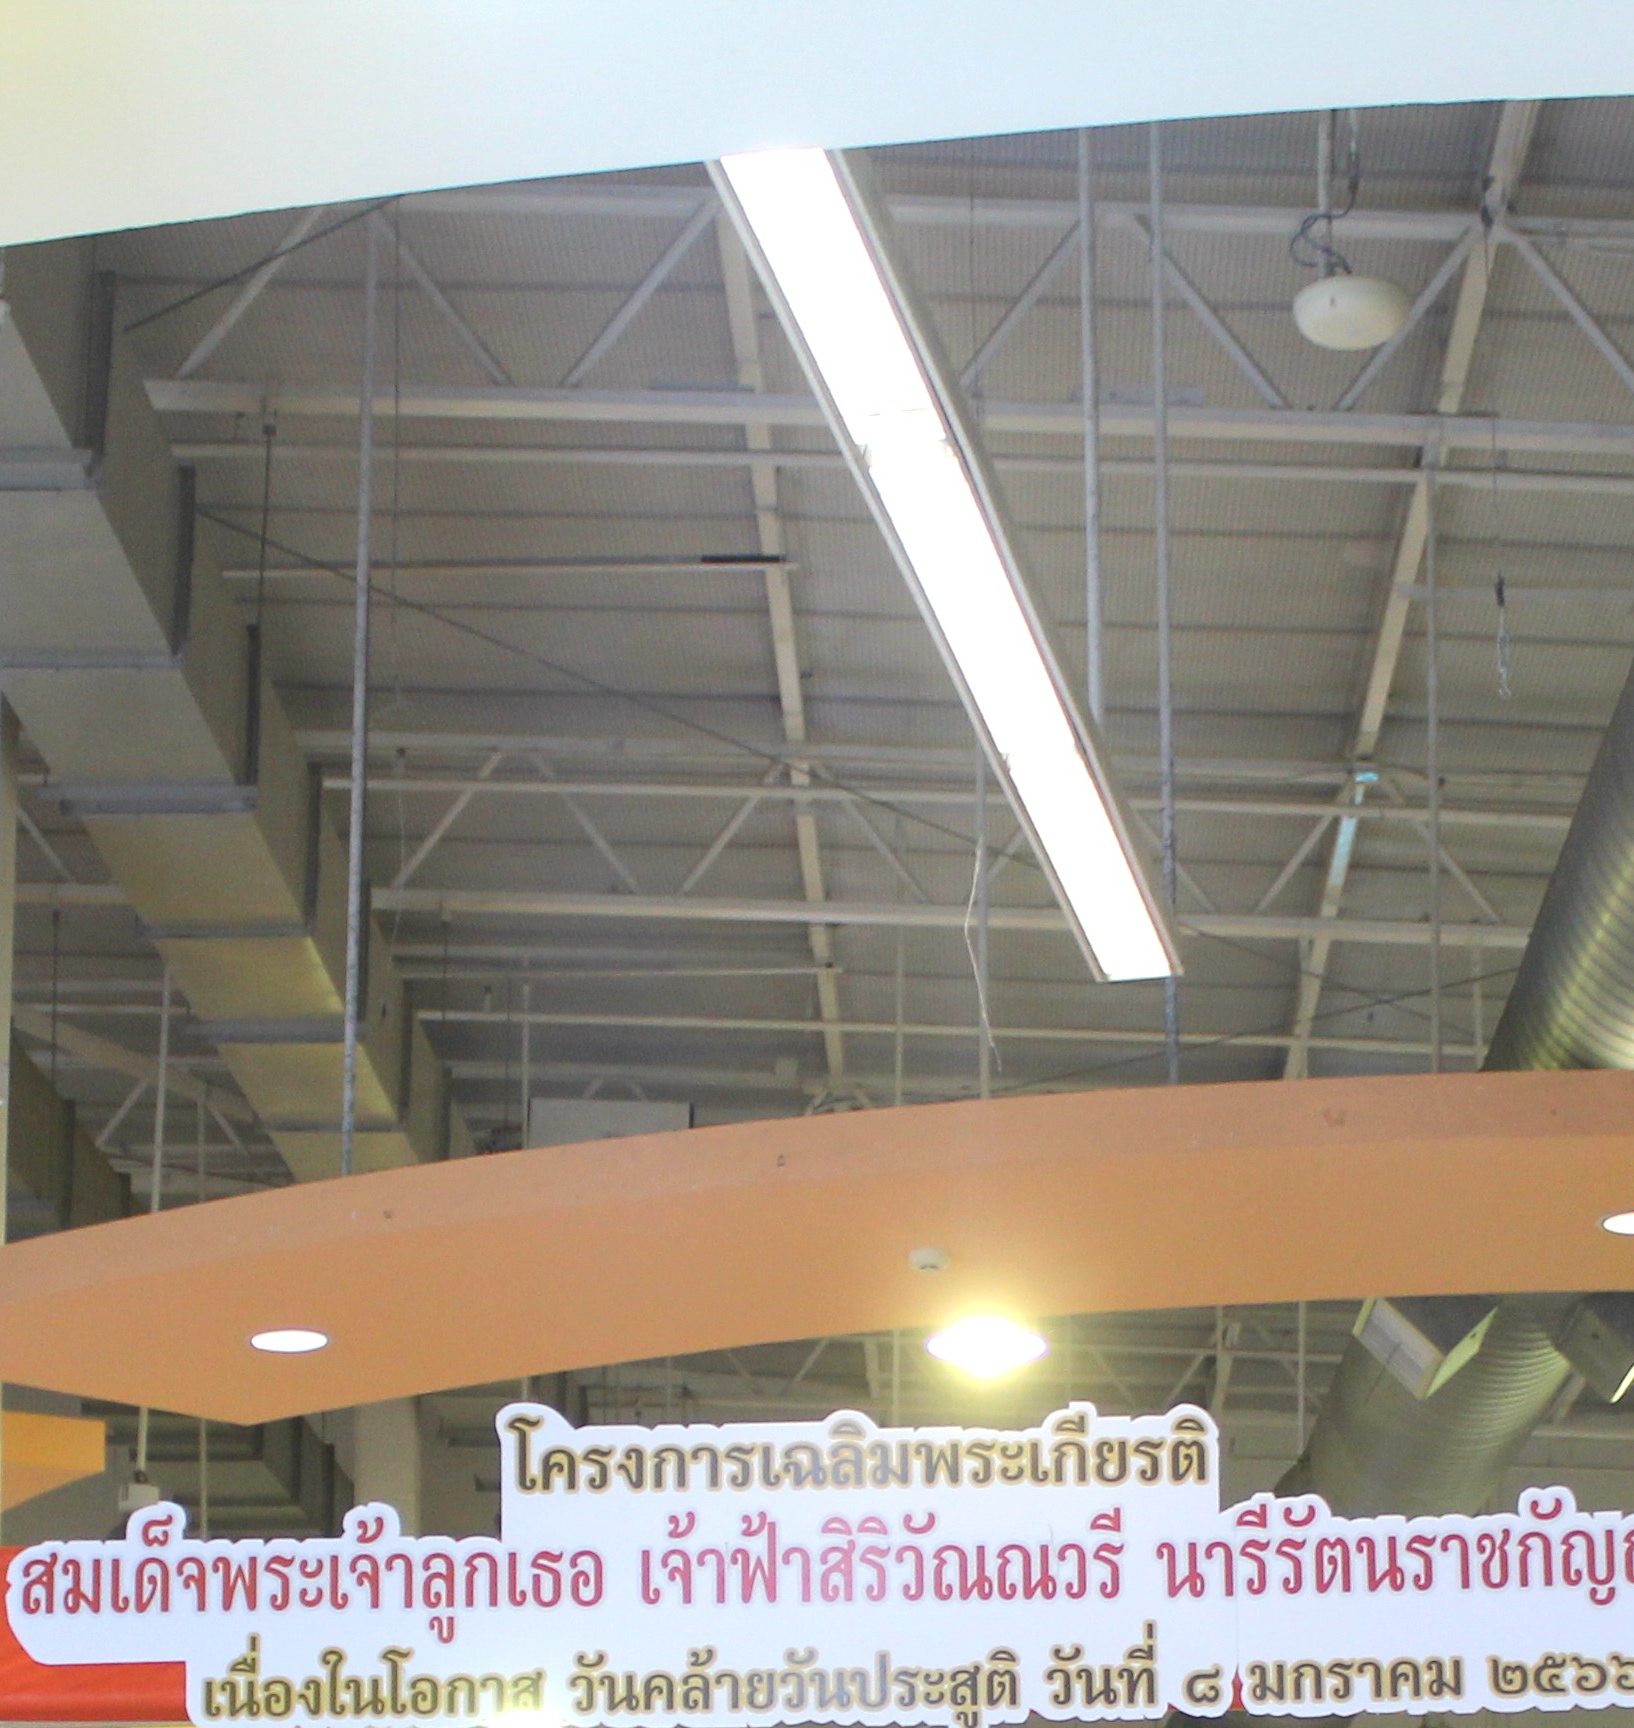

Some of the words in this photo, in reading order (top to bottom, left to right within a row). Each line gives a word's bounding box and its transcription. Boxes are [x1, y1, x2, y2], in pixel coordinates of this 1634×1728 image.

[506, 1413, 1210, 1491] โครงการเฉลิมพระเกียรติ
[21, 1514, 604, 1643] สมเด็จพระเจ้าลูกเธอ
[640, 1507, 1124, 1612] เจ้าฟ้าสิริวัณณวรี
[203, 1636, 544, 1717] เนื่องในโอกาส
[572, 1645, 1019, 1728] วันคล้ายวันประสูติ
[1045, 1621, 1156, 1708] วันที่
[1185, 1664, 1220, 1705] ๘
[1251, 1656, 1464, 1701] มกราคม
